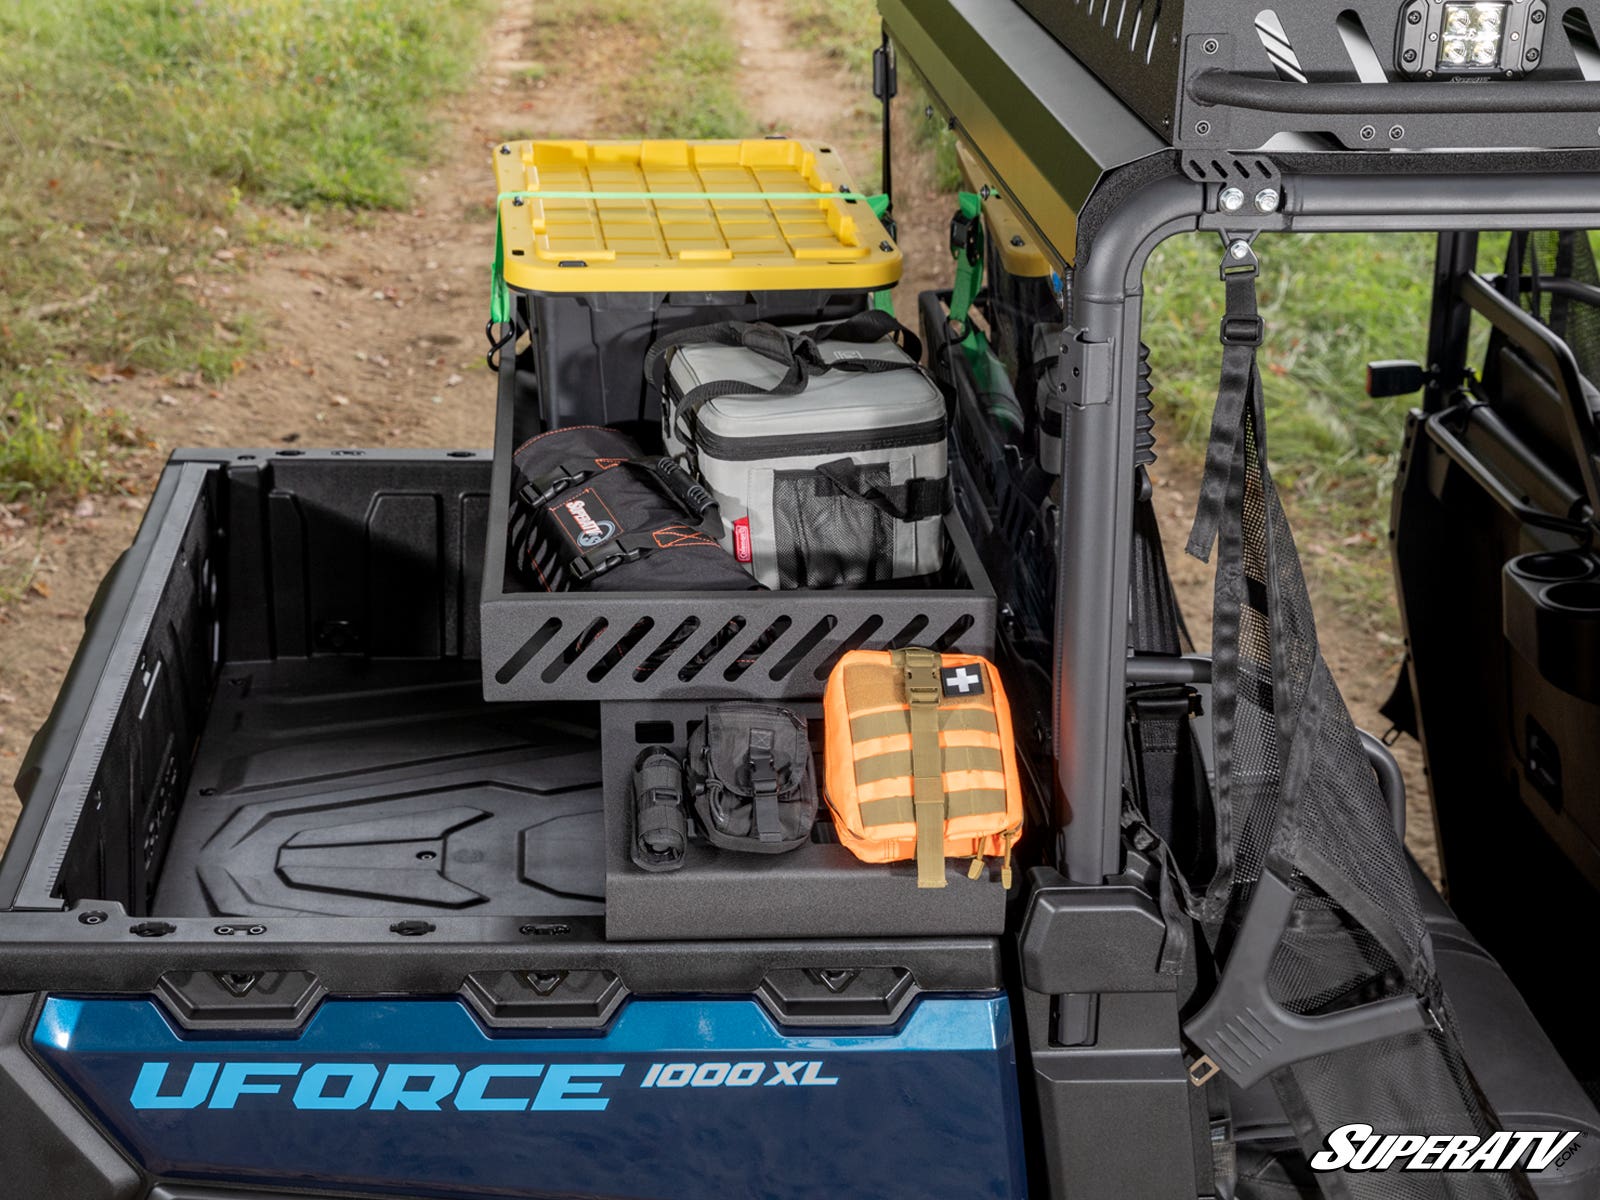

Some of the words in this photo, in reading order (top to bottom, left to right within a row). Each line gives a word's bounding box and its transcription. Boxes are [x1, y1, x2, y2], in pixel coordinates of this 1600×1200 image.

[130, 1062, 626, 1111] UFORCE
[640, 1062, 767, 1088] 1000
[763, 1061, 839, 1087] XL
